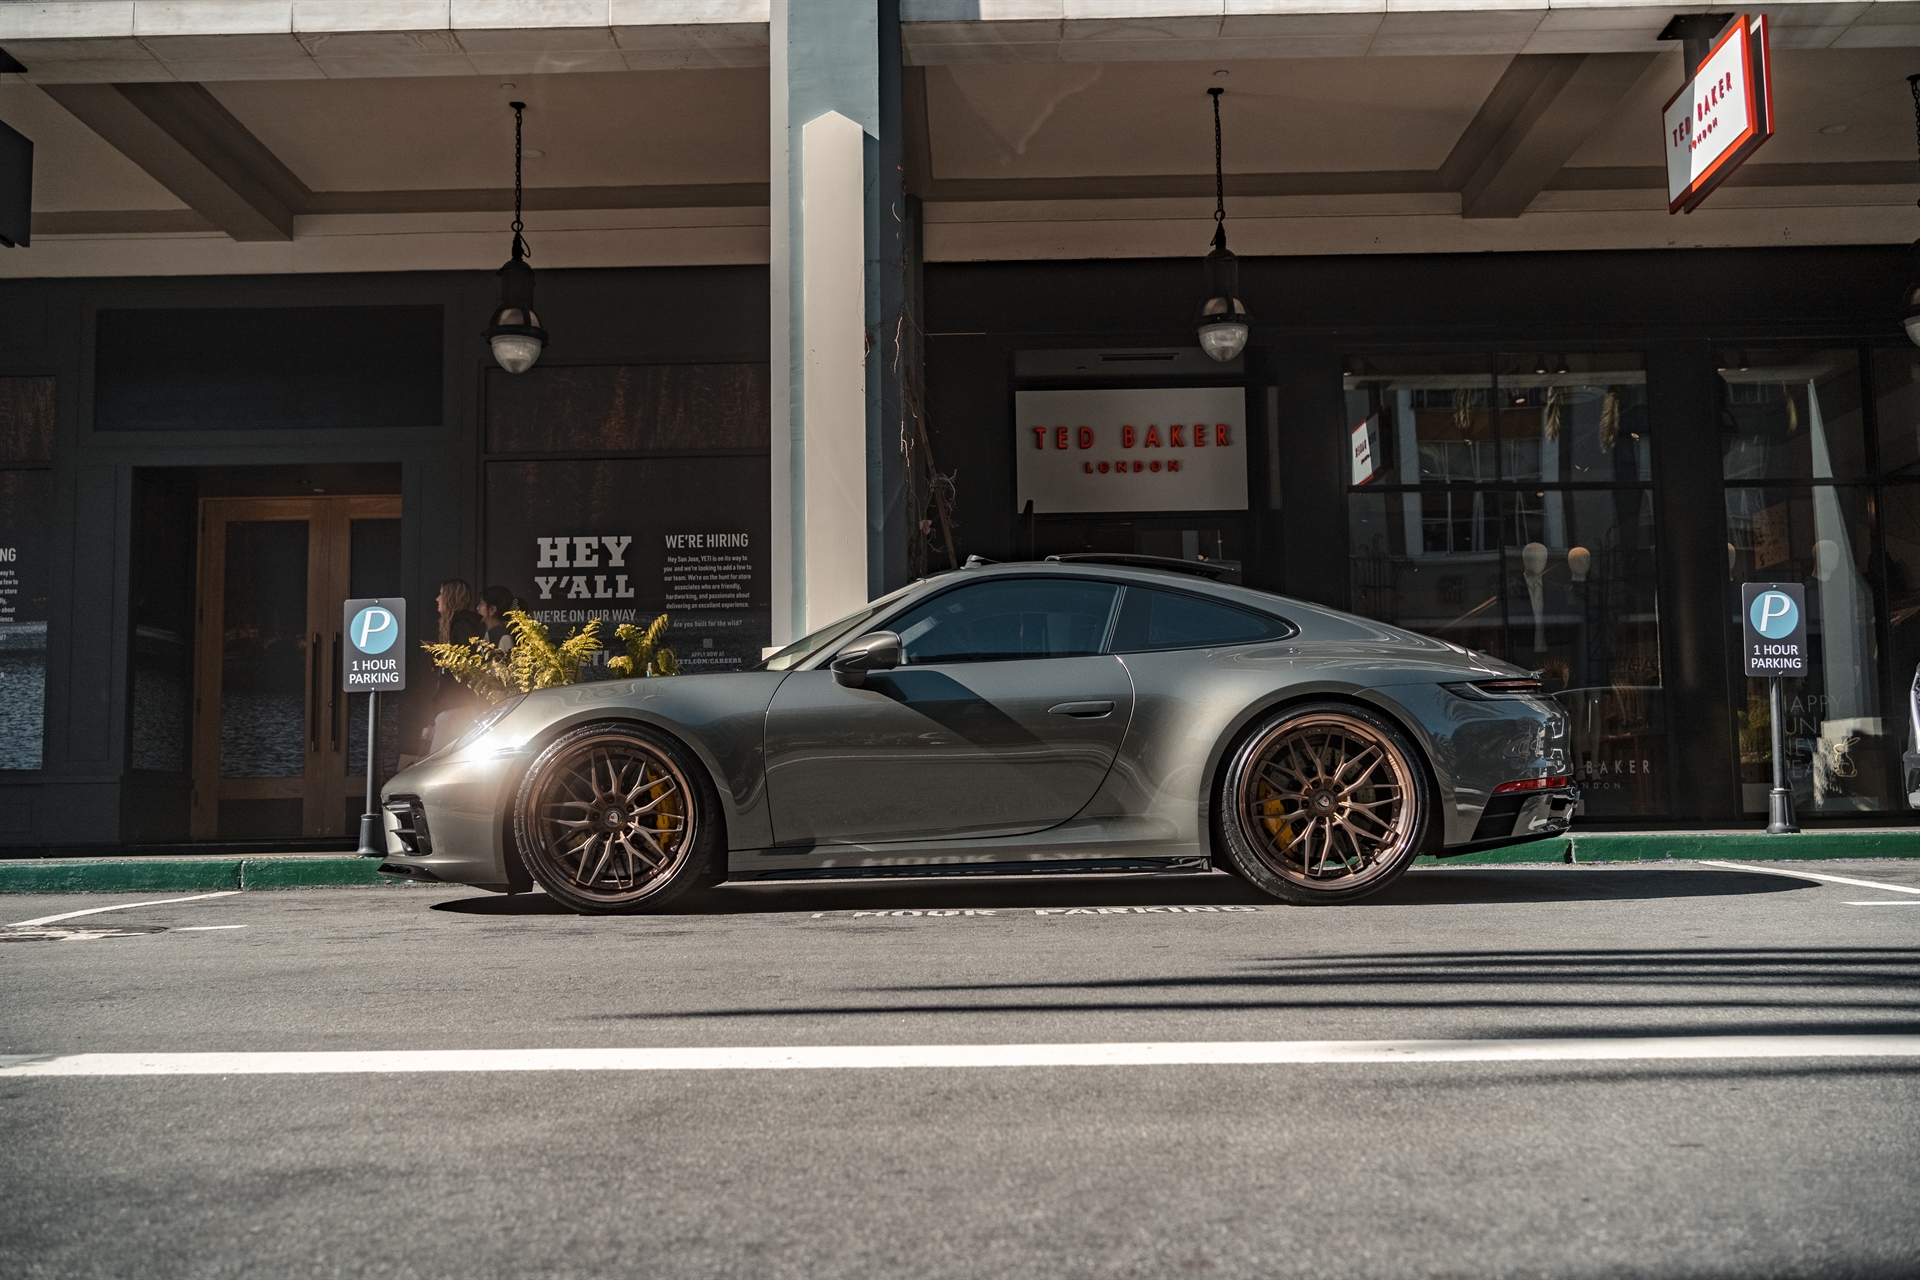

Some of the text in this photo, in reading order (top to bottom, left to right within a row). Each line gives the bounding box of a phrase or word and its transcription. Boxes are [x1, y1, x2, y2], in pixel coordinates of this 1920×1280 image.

[1672, 71, 1733, 148] TED BAKER
[1688, 117, 1718, 153] LONDON
[1034, 424, 1229, 450] TED BAKER
[1084, 460, 1179, 474] LONDON
[665, 533, 748, 548] WE'RE HIRING
[537, 536, 632, 568] HEY
[535, 575, 634, 599] Y'ALL
[721, 583, 741, 591] friendly,
[666, 593, 698, 601] hardworking,
[569, 610, 584, 622] ON
[587, 610, 609, 622] OUR
[612, 609, 636, 621] WAY
[1760, 594, 1790, 632] P
[360, 610, 391, 648] P
[1753, 644, 1798, 655] 1 HOUR
[352, 659, 396, 671] 1 HOUR
[1751, 658, 1801, 668] PARKING
[349, 672, 399, 684] PARKING
[1784, 694, 1844, 713] APPY
[1586, 760, 1651, 774] BAKER
[1582, 782, 1621, 790] NDON
[1034, 906, 1258, 915] PARKING
